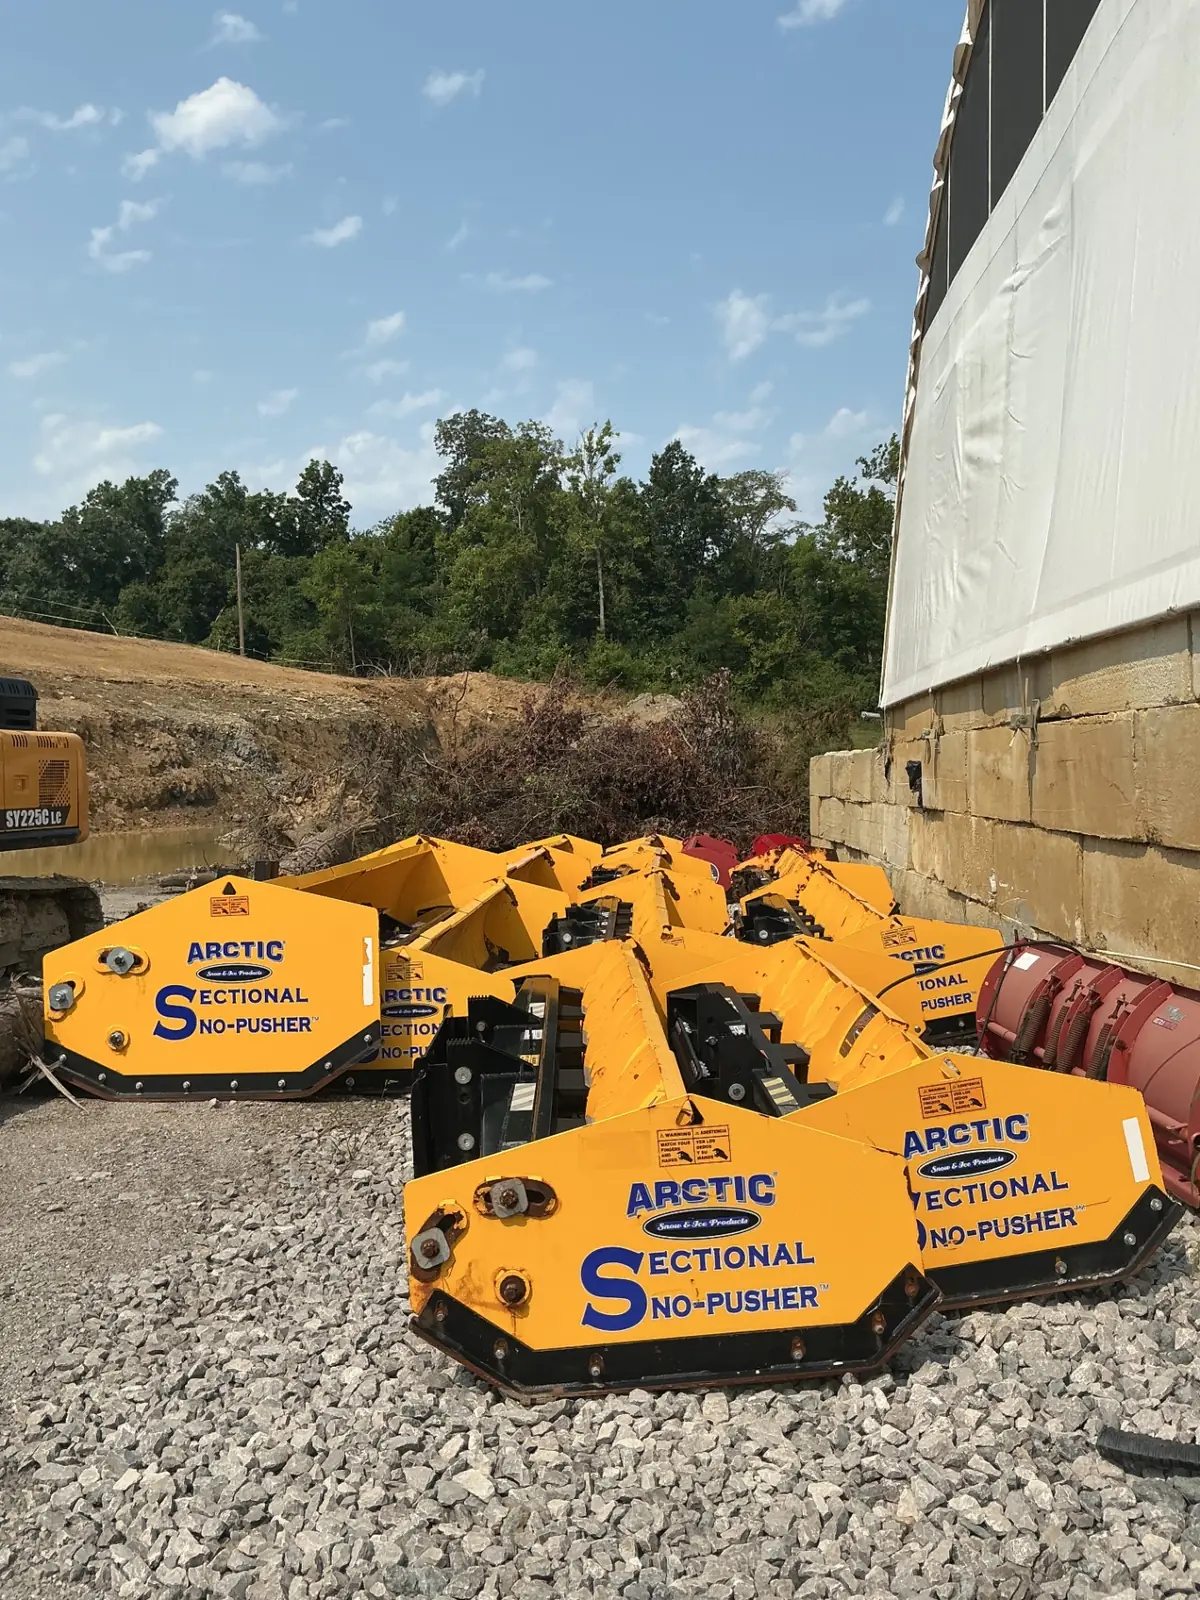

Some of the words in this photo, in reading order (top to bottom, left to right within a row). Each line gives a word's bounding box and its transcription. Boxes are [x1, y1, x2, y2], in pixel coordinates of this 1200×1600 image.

[6, 809, 50, 828] SY225C
[187, 941, 284, 964] ARCTIC
[888, 945, 946, 961] CTIC
[917, 974, 968, 991] IONAL
[383, 987, 447, 1004] RCTIC
[921, 993, 973, 1011] PUSHER
[381, 1023, 440, 1037] ECTION
[903, 1114, 1029, 1160] ARCTIC
[930, 1165, 951, 1174] Snow
[951, 1162, 958, 1170] &
[958, 1161, 971, 1169] Ice
[972, 1155, 1004, 1166] Products
[626, 1174, 777, 1219] ARCTIC
[914, 1171, 1068, 1213] ECTIONAL
[657, 1222, 681, 1231] Snow
[683, 1221, 691, 1229] &
[691, 1220, 708, 1228] Ice
[708, 1217, 749, 1227] Products
